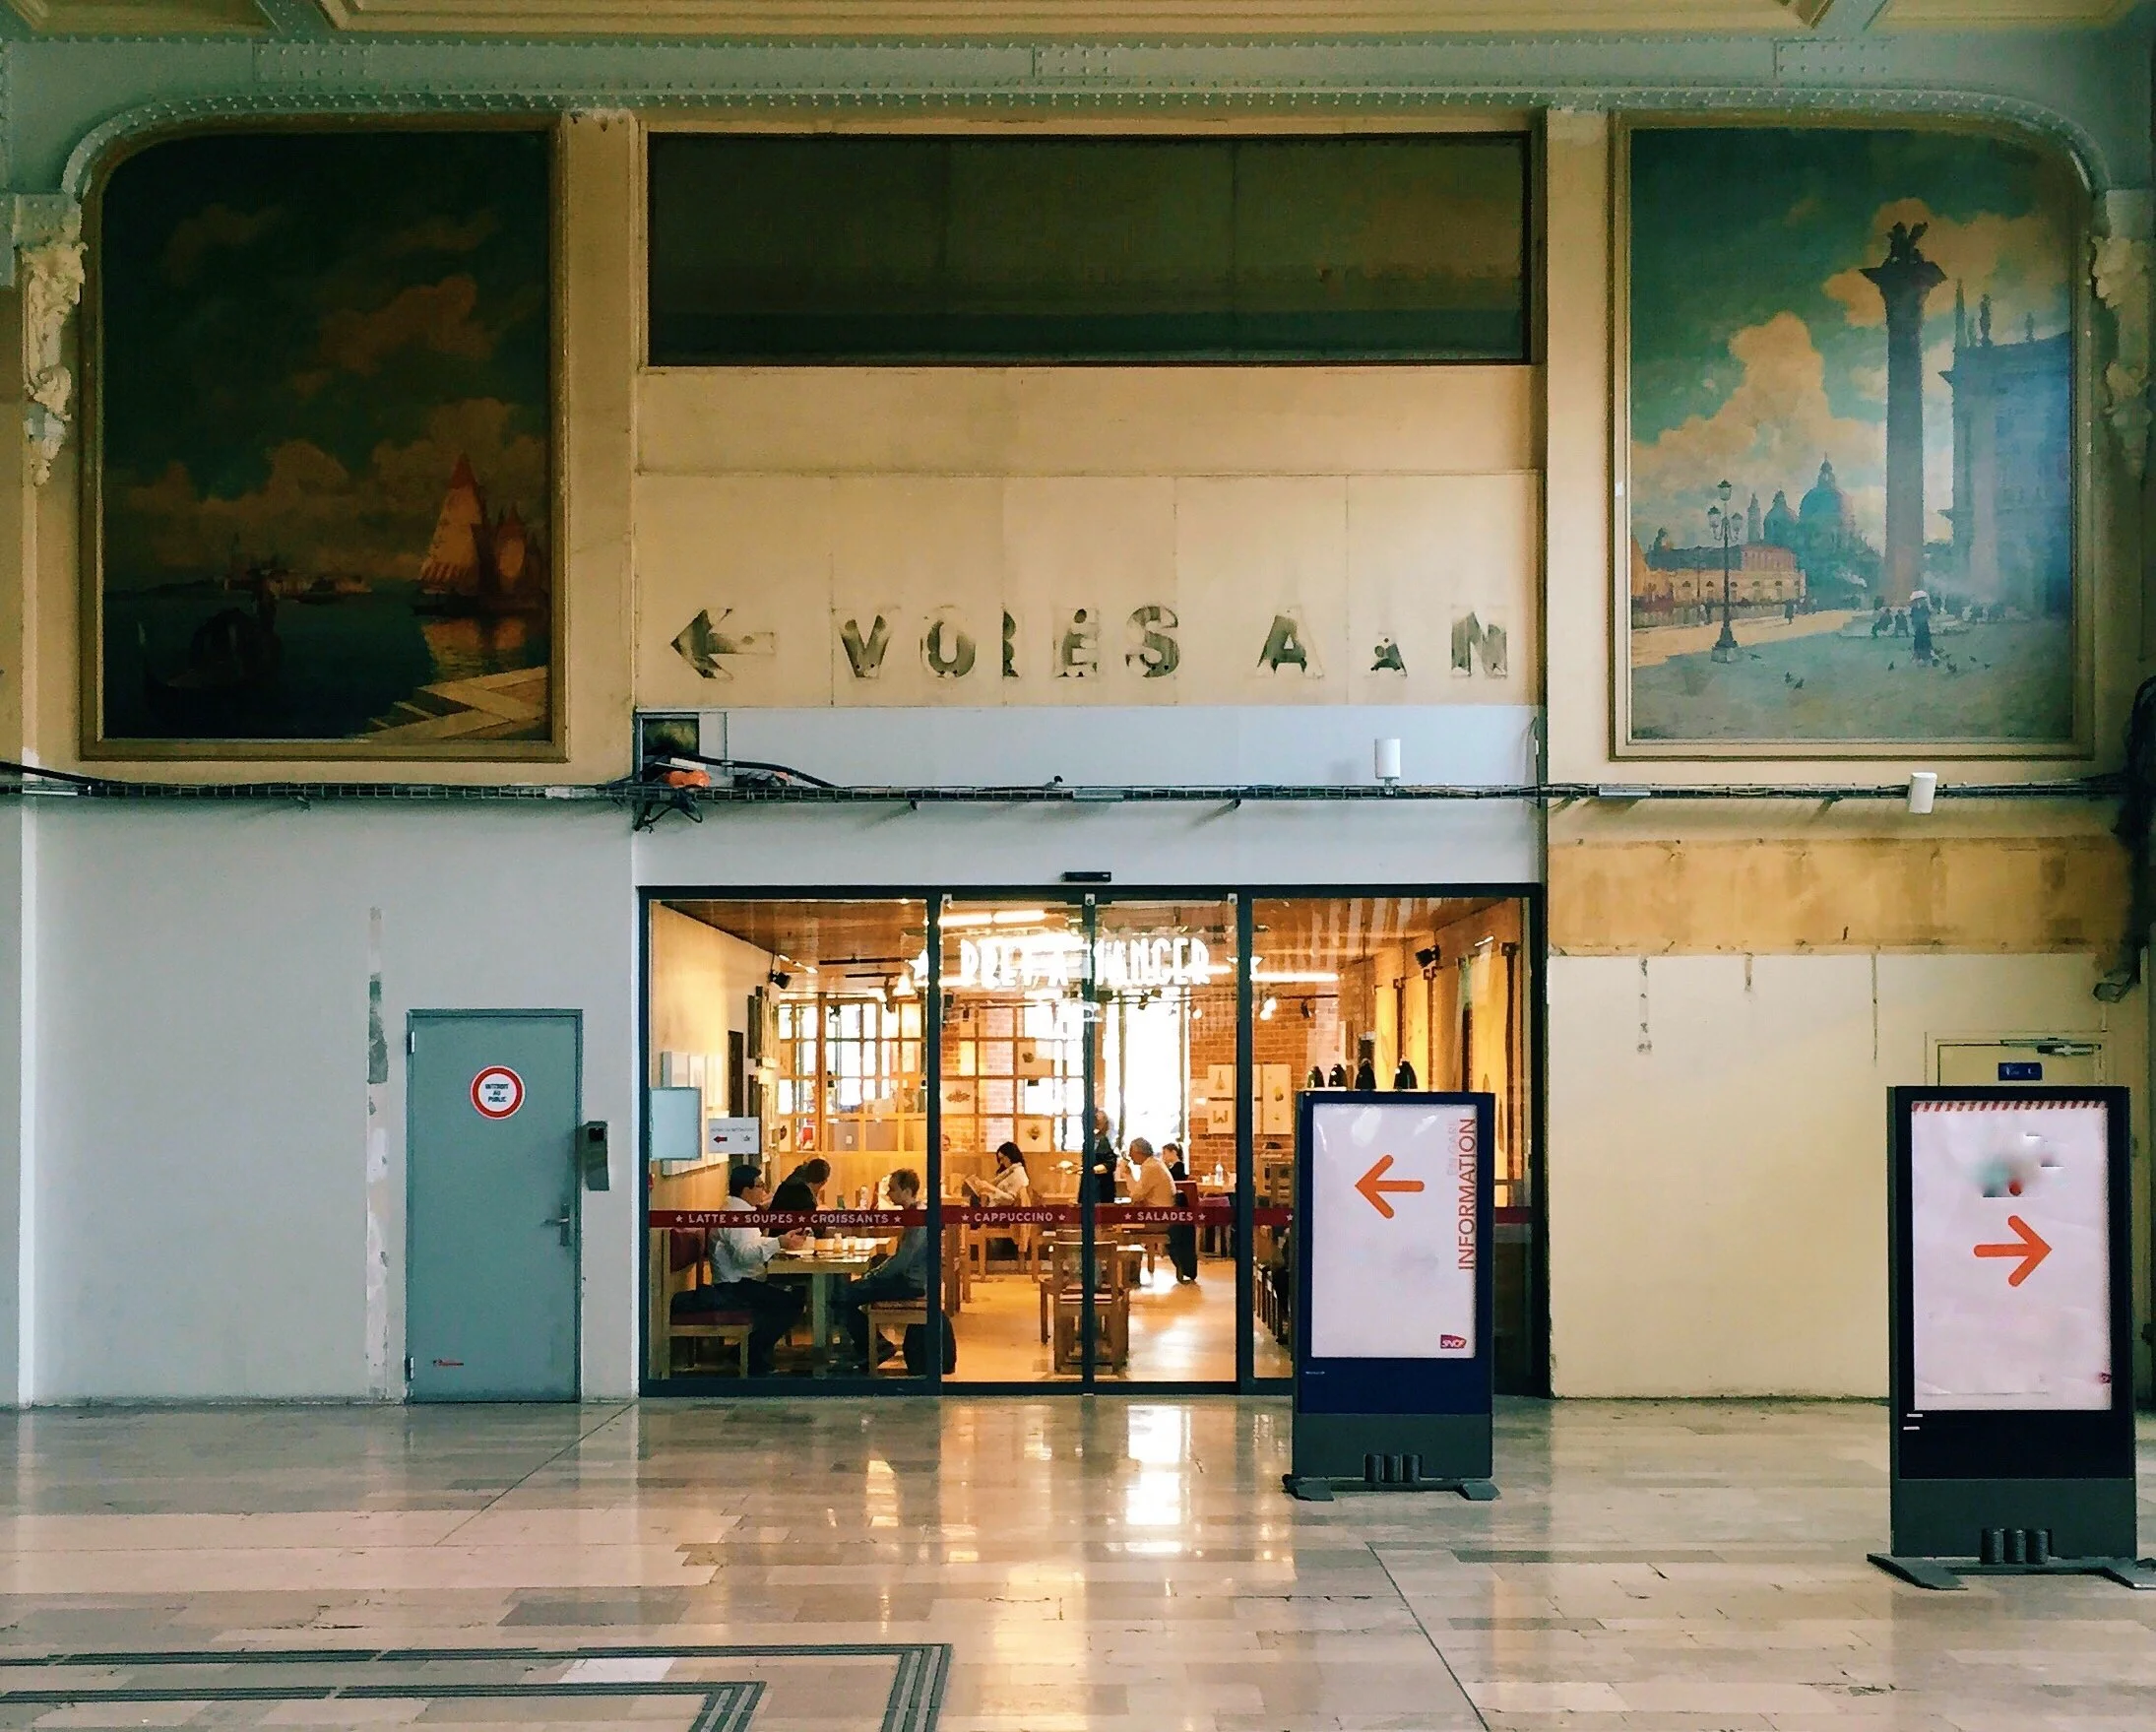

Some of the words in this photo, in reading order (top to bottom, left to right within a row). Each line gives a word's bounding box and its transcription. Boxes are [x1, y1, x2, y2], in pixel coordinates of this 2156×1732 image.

[830, 605, 1179, 678] VOIES
[1458, 1118, 1476, 1270] INFORMATION
[688, 1213, 727, 1224] LATTE
[744, 1213, 793, 1224] SOUPES
[810, 1213, 889, 1224] CROISSANTS
[974, 1212, 1053, 1222] CAPPUCCINO
[1137, 1211, 1193, 1221] SALADES
